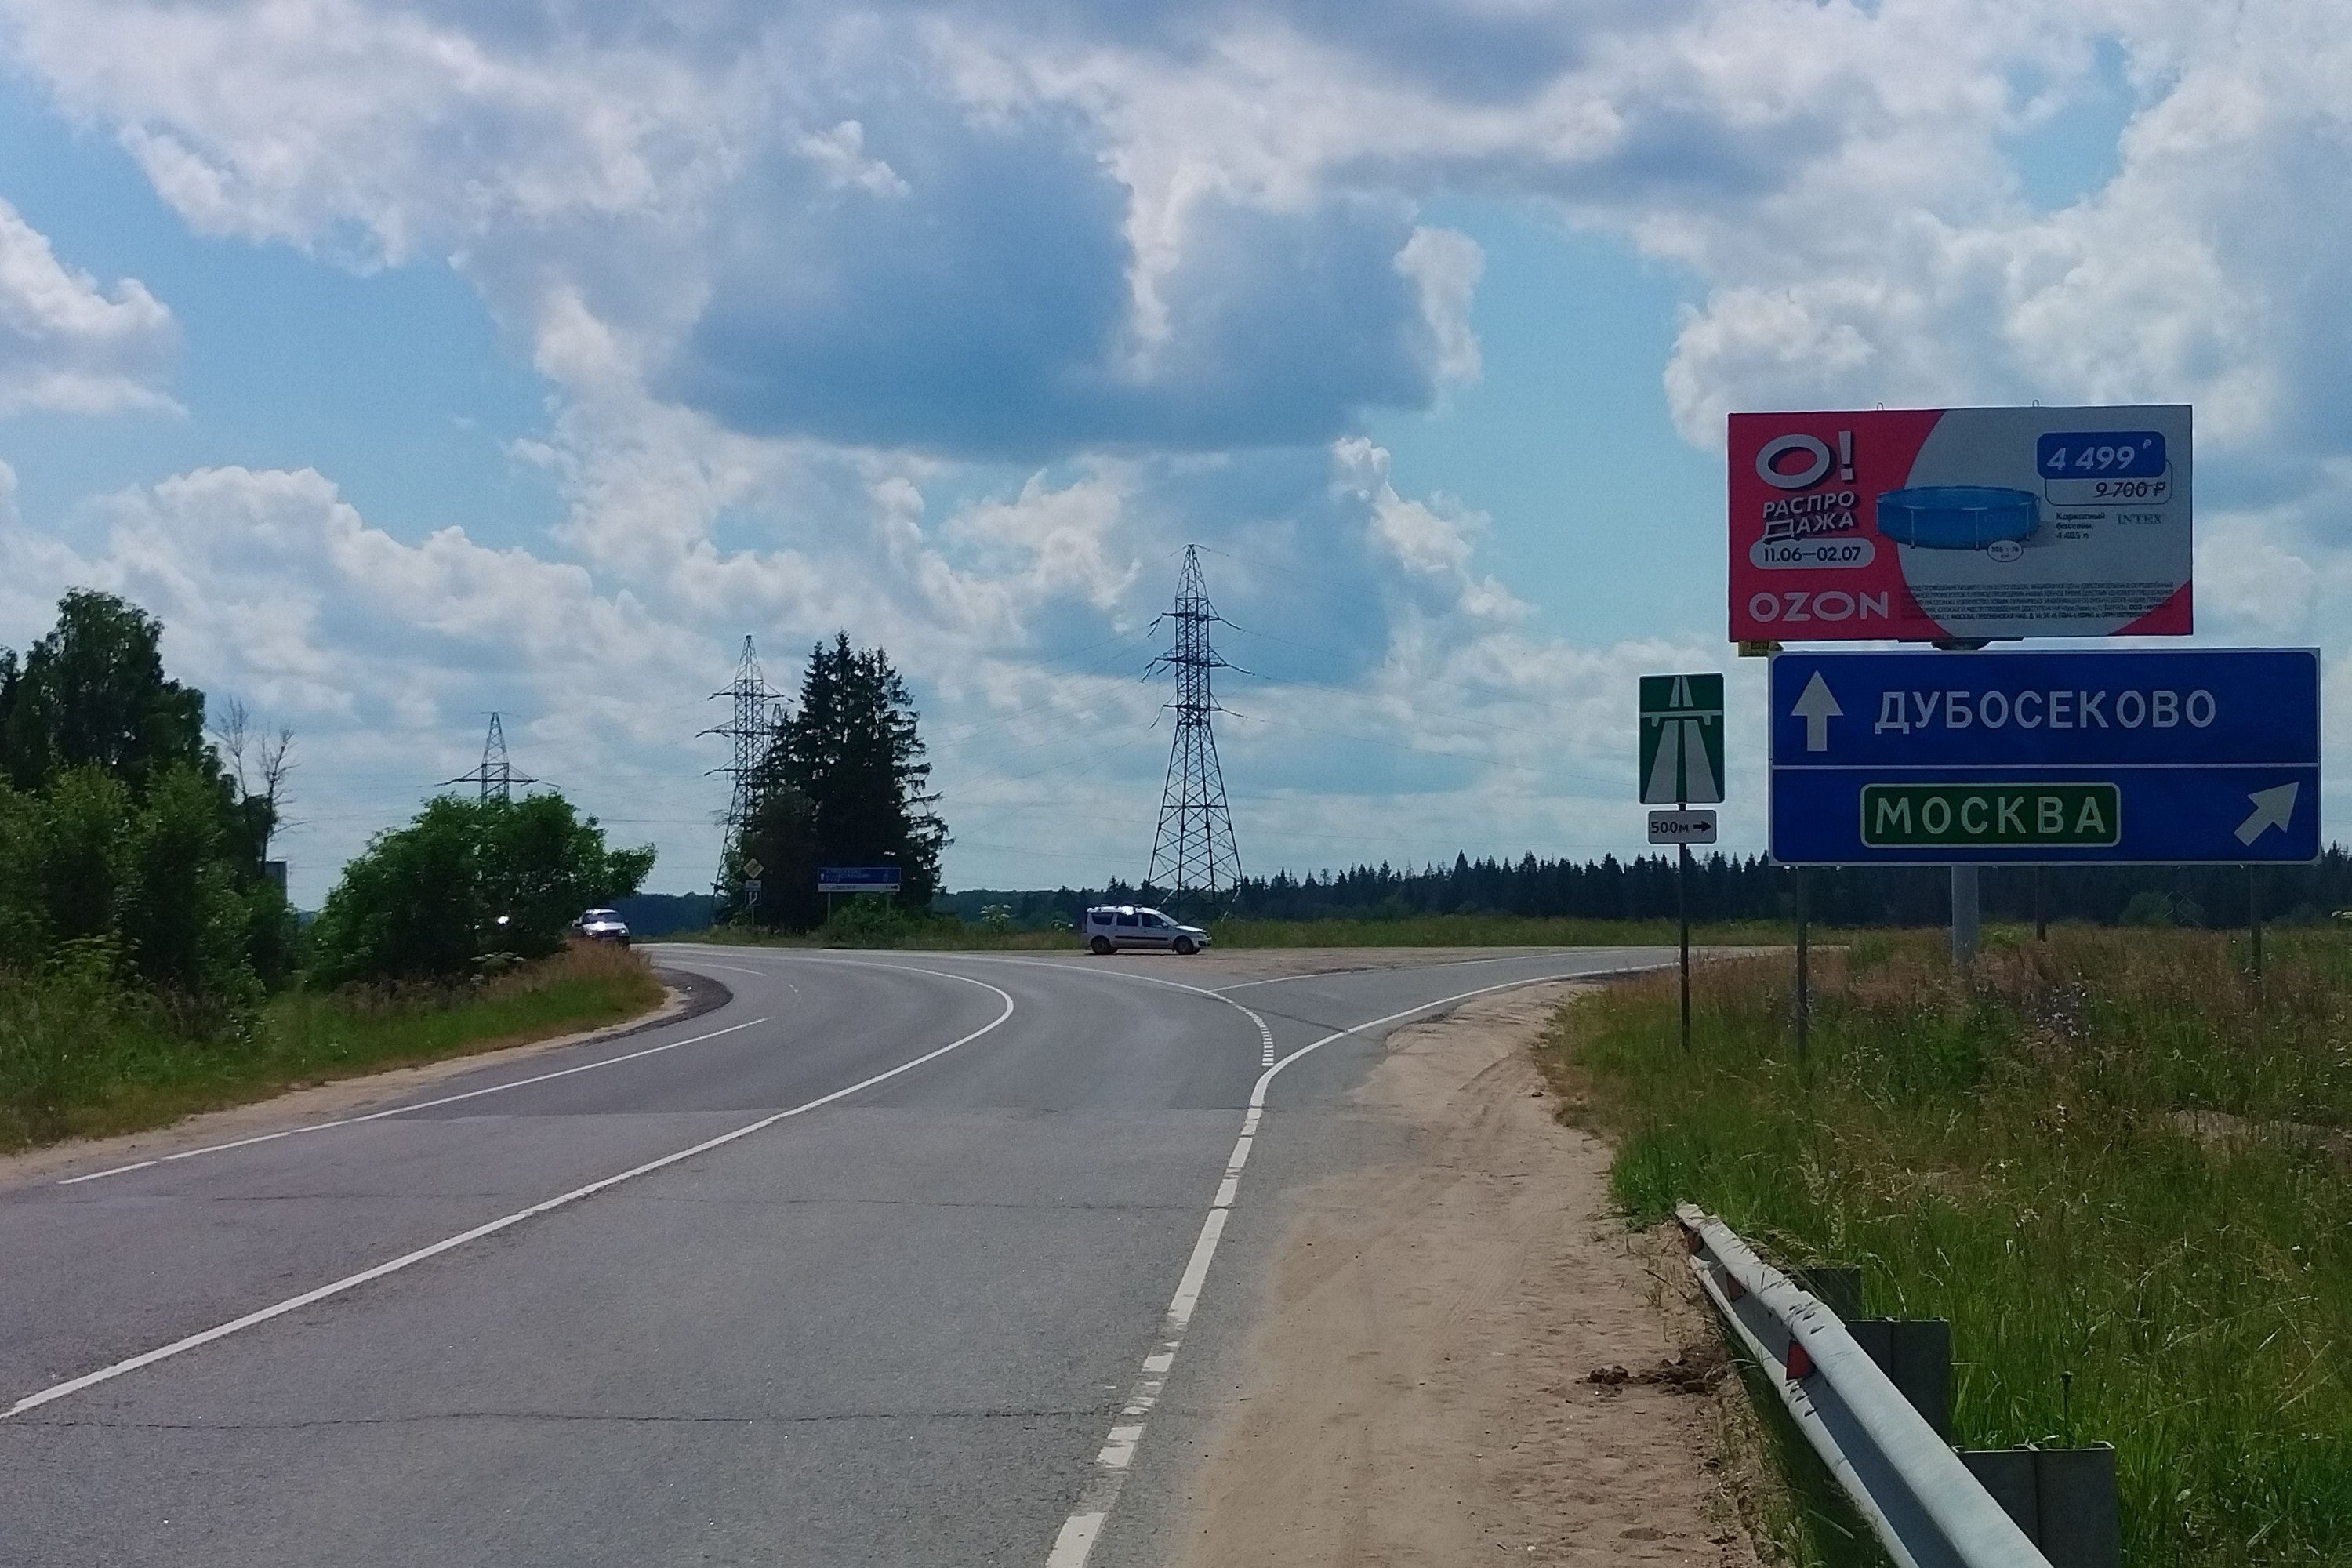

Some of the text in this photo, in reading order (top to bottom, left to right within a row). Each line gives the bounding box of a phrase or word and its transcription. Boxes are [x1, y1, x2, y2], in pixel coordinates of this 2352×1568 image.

[1762, 490, 1855, 519] РАСПРО
[2117, 514, 2164, 525] INTEX
[1762, 511, 1854, 539] ДАЖА
[1748, 591, 1889, 622] OZON
[1874, 689, 2217, 735] ДУБОСЕКОВО
[1875, 795, 2107, 836] МОСКВА
